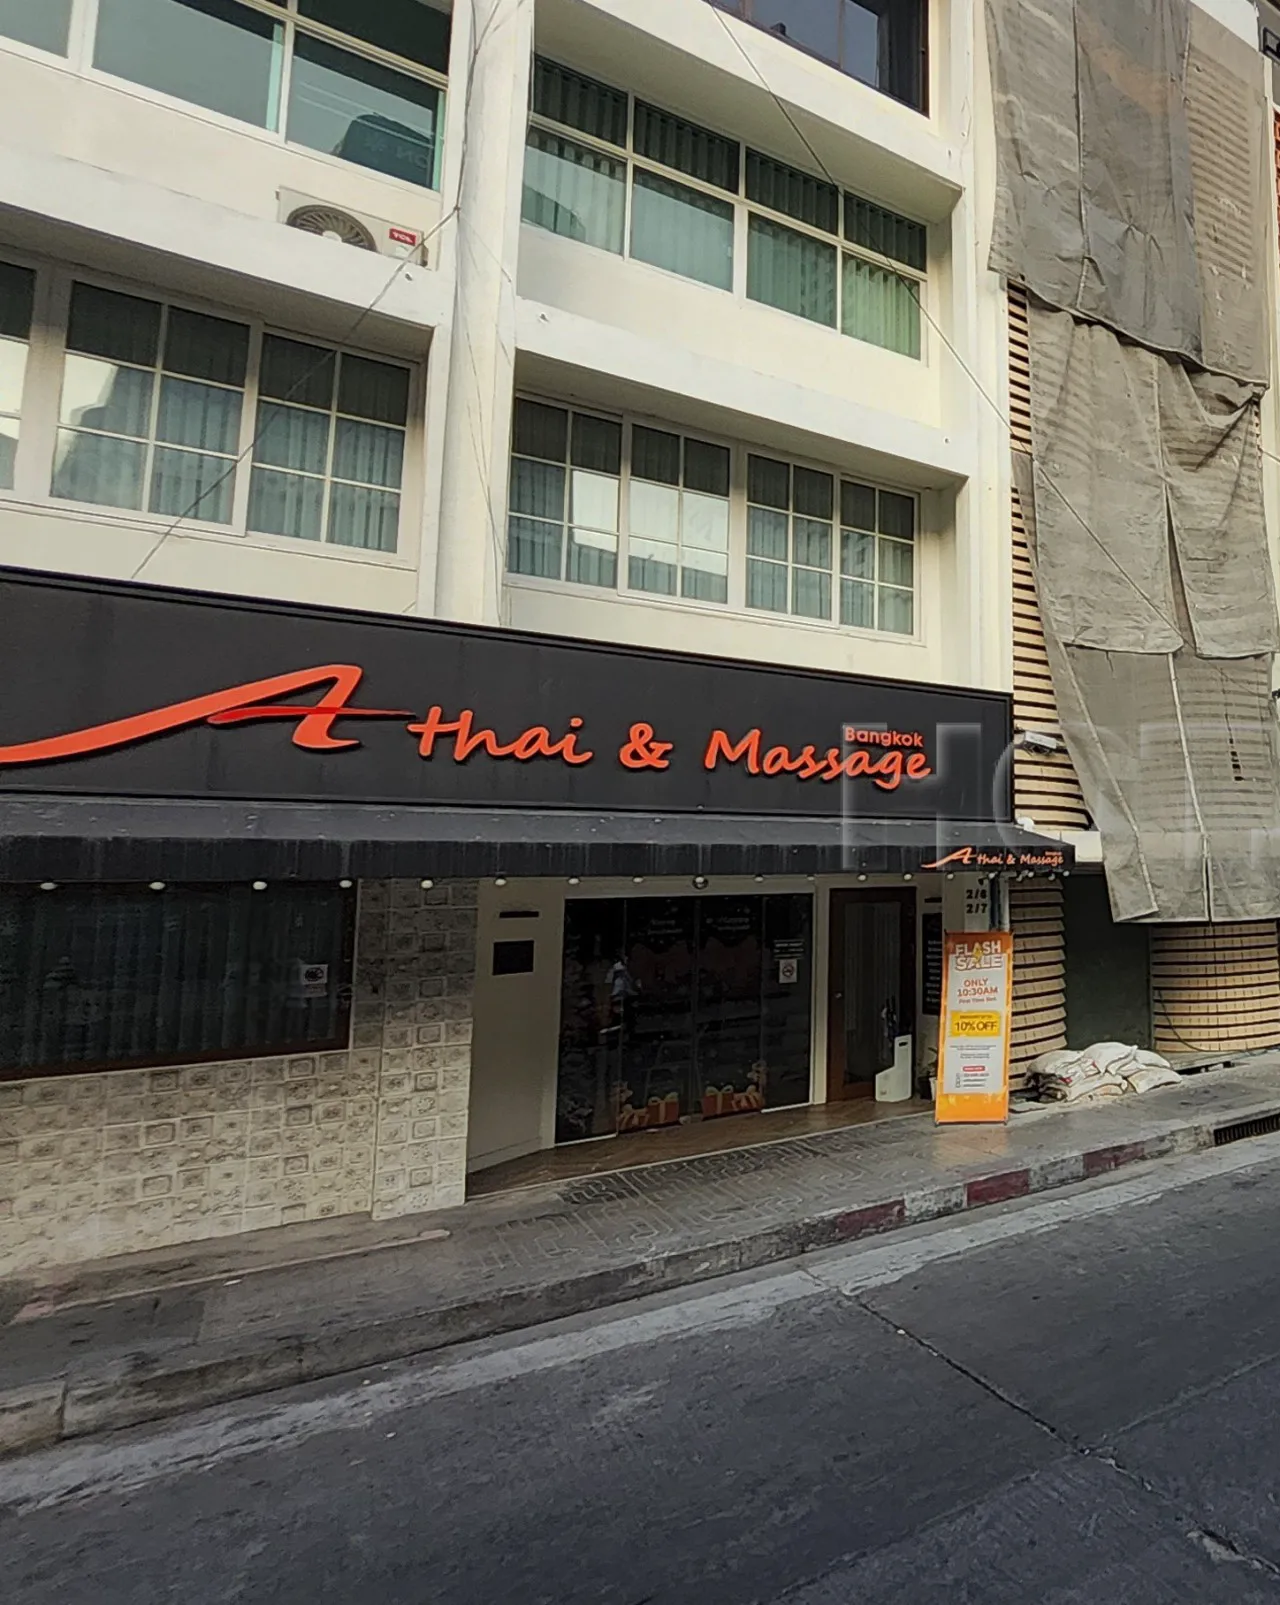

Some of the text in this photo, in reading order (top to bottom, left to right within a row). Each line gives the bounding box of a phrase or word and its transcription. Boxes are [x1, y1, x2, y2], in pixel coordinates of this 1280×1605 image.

[844, 726, 924, 748] Bangkok
[407, 705, 593, 762] thai
[619, 722, 673, 770] &
[704, 728, 931, 790] Massage
[977, 853, 1002, 865] thai
[1006, 856, 1016, 865] &
[1020, 853, 1064, 867] Massage
[966, 904, 987, 914] 2/7
[955, 940, 1002, 957] FLASH
[955, 954, 1003, 971] SALE
[963, 978, 988, 987] ONLY
[957, 986, 999, 997] 10:30AM
[954, 1020, 998, 1032] 10% OFF
